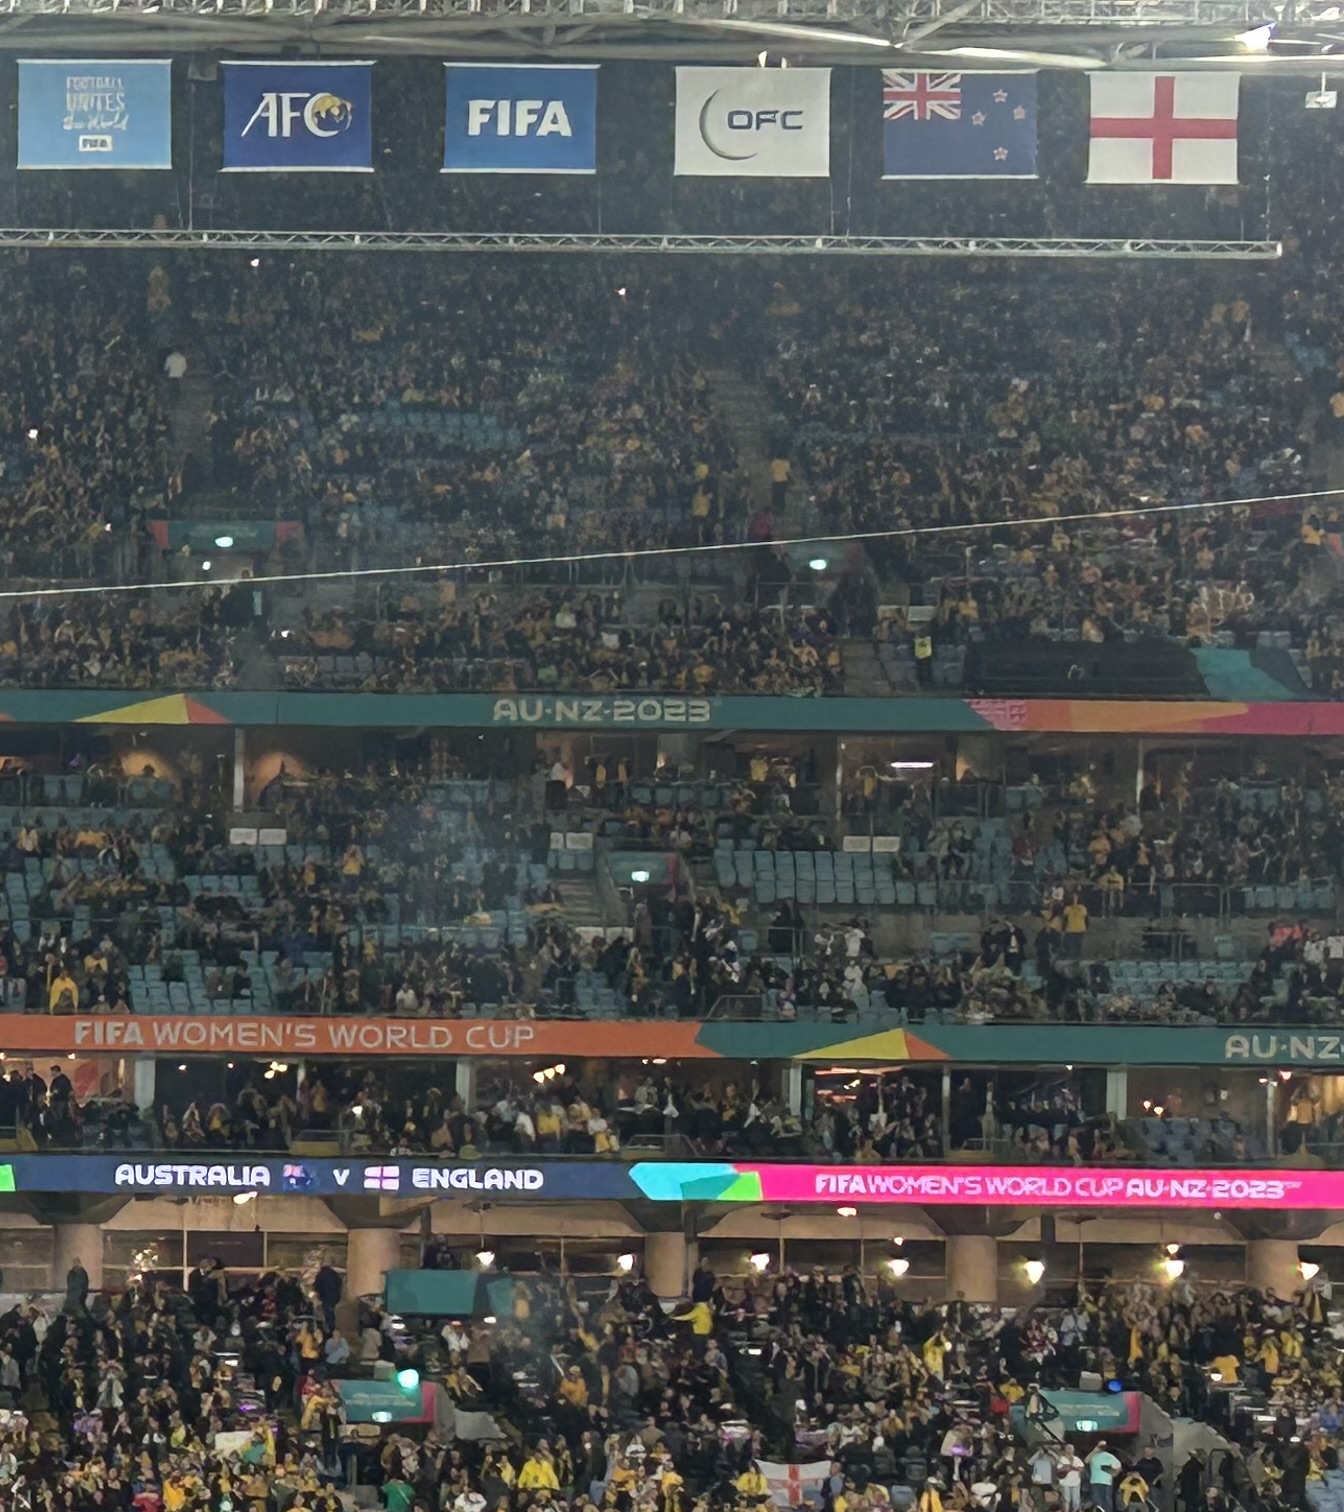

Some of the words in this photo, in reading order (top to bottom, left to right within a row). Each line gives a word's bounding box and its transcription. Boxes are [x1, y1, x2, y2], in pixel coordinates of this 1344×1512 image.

[241, 92, 352, 138] AFC
[467, 99, 573, 137] FIFA
[727, 110, 804, 131] OFC
[74, 1020, 143, 1046] FIFA
[152, 1021, 316, 1048] WOMEN'S
[328, 1024, 451, 1050] WORLD
[465, 1025, 536, 1050] CUP
[114, 1163, 271, 1187] AUSTRALIA
[412, 1168, 544, 1190] ENGLAND
[815, 1173, 867, 1194] FIFA
[868, 1174, 982, 1195] WOMEN'S
[985, 1176, 1072, 1198] WORLD
[1074, 1177, 1124, 1199] CUP
